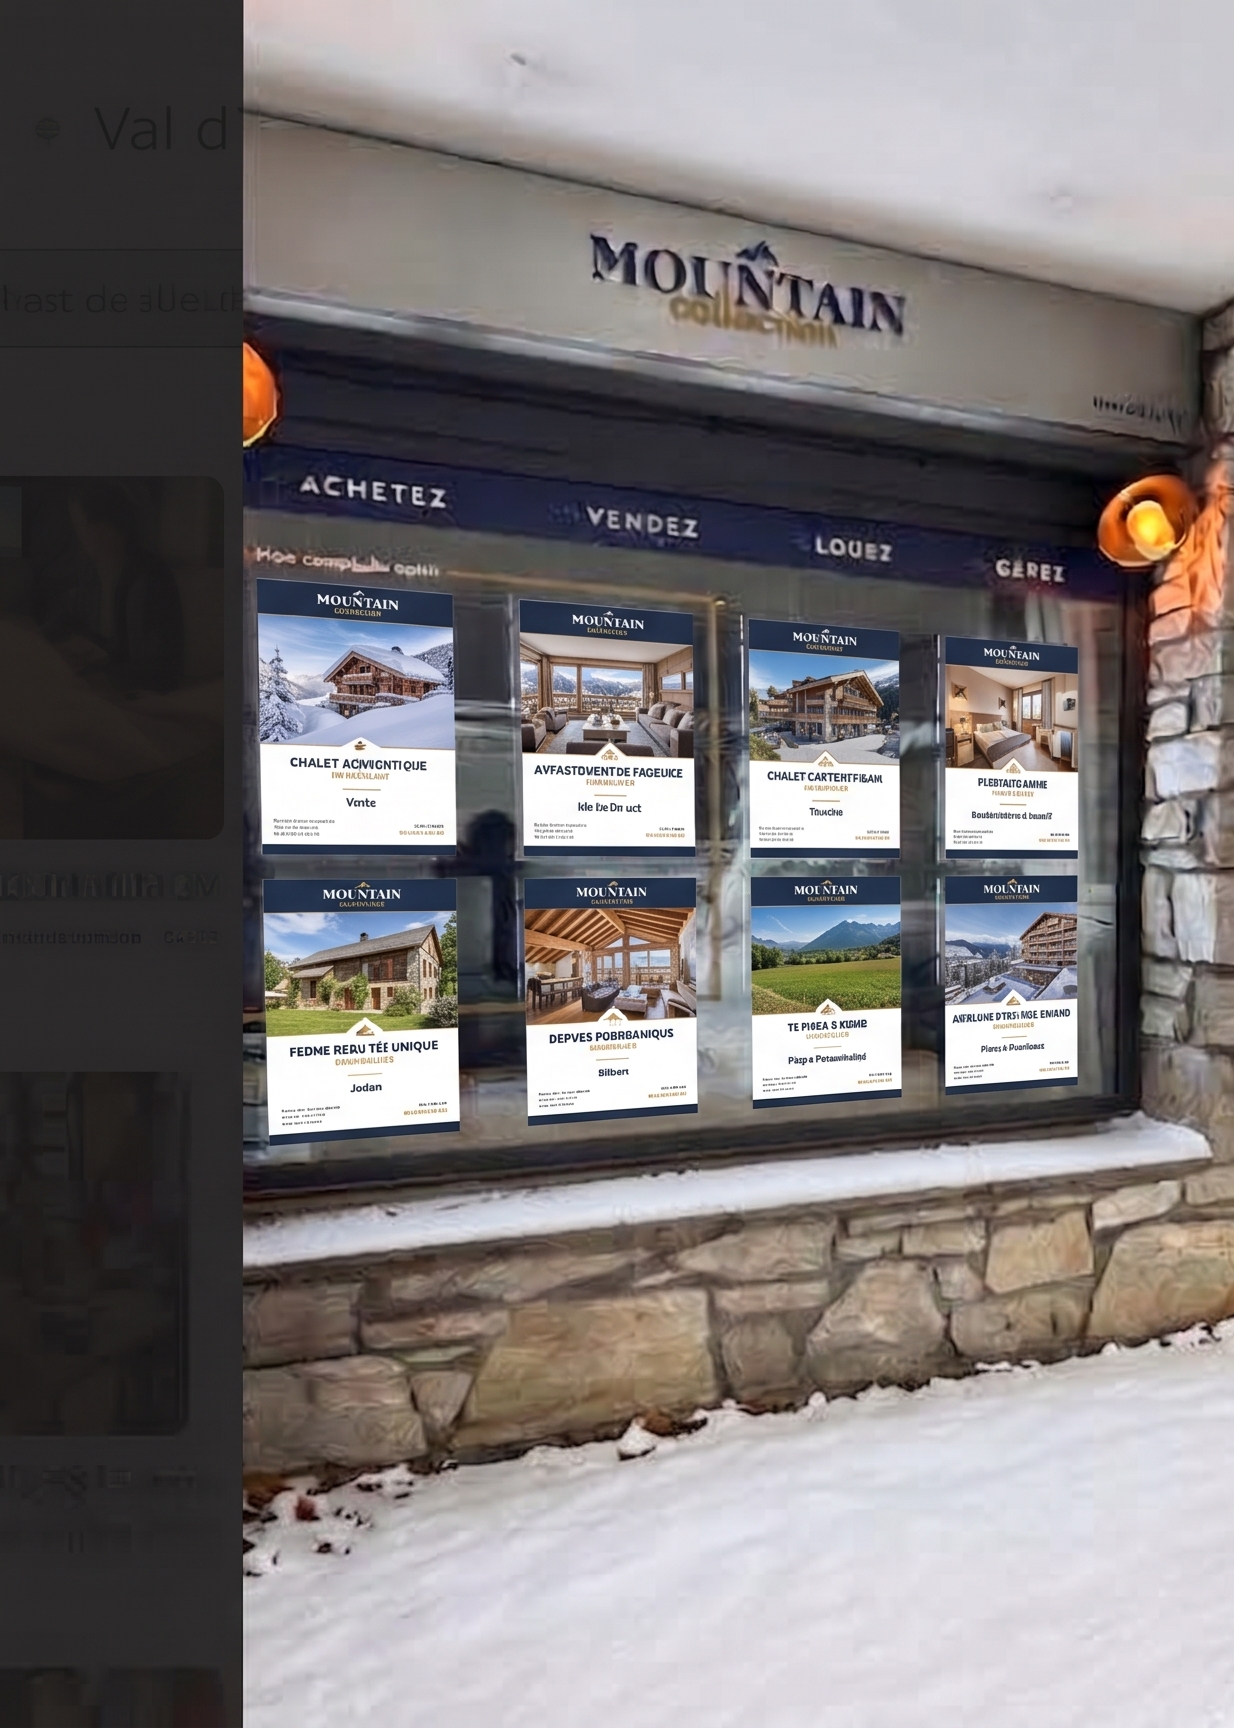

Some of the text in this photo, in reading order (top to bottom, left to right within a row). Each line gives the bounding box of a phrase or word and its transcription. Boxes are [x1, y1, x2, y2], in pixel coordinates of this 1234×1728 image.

[590, 234, 906, 334] MOUNTAIN
[300, 475, 447, 508] ACHETEZ
[586, 506, 699, 538] VENDEZ
[815, 536, 893, 562] LOUEZ
[317, 593, 400, 611] MOUNTAIN
[572, 614, 645, 630] MOUNTAIN
[792, 631, 858, 646] MOUNTAIN
[290, 757, 339, 769] CHALET
[767, 771, 806, 782] CHALET
[323, 889, 401, 900] MOUNTAIN
[576, 887, 647, 898] MOUNTAIN
[794, 885, 858, 896] MOUNTAIN
[983, 884, 1040, 894] MOUNTAIN
[391, 1040, 439, 1053] UNIQUE
[350, 1082, 383, 1093] Jodan
